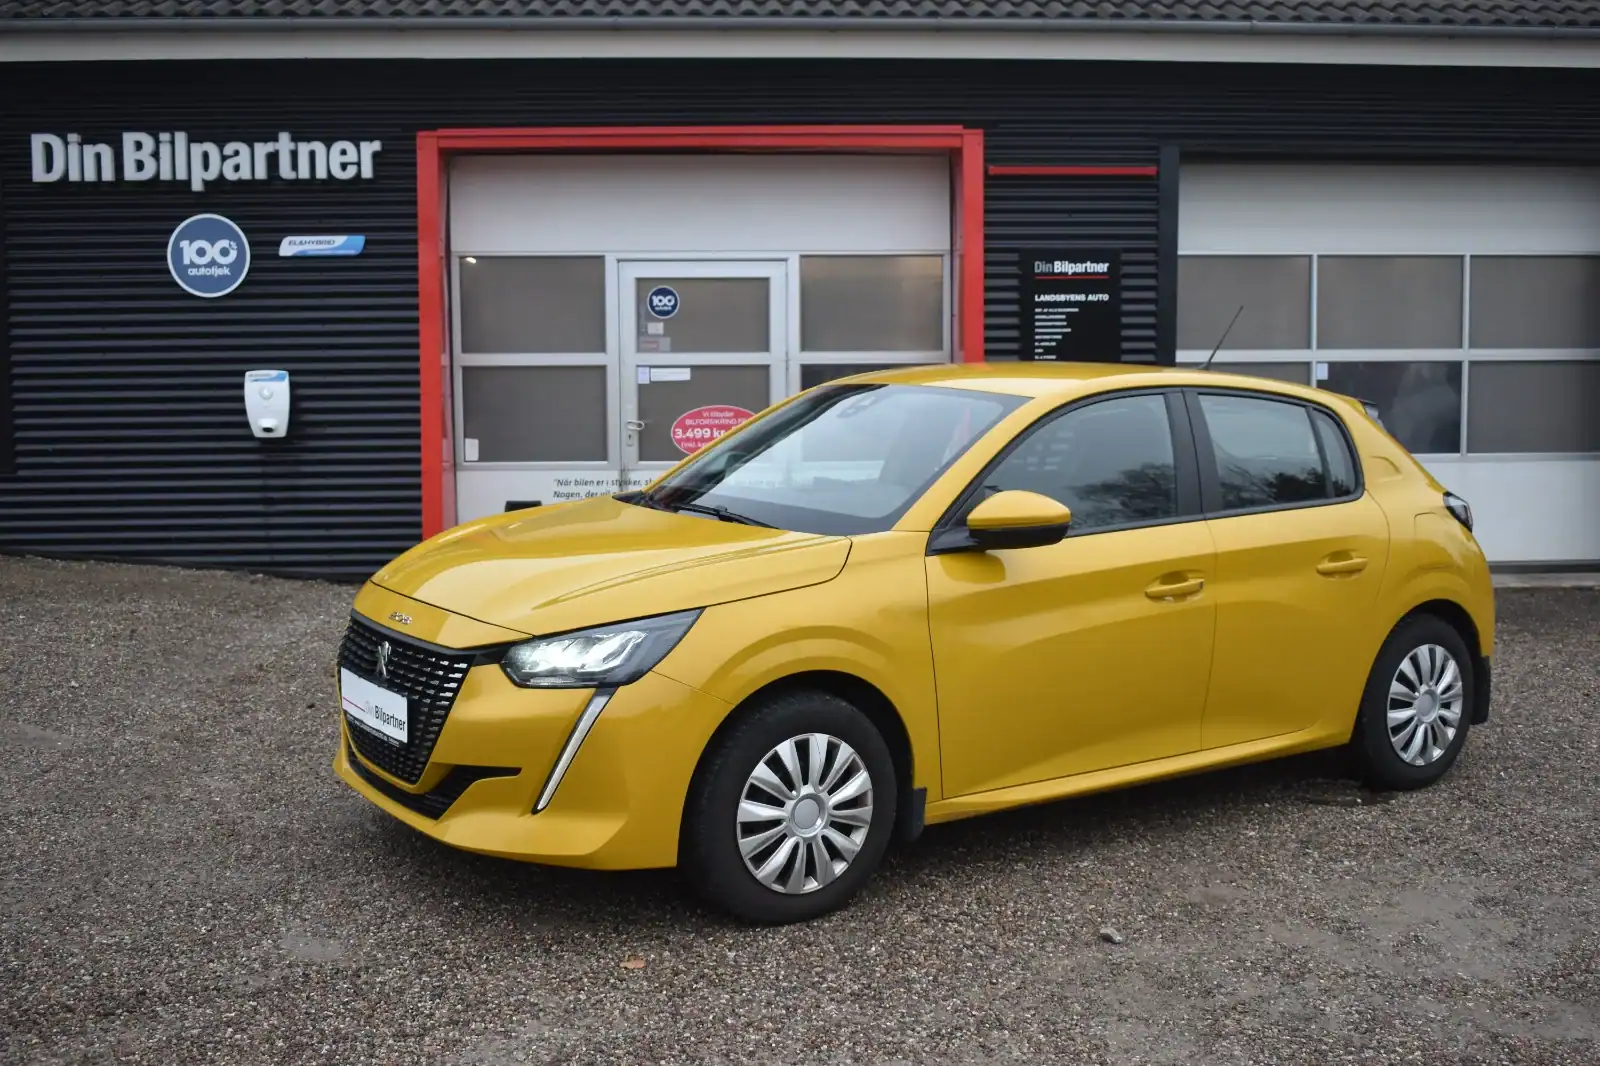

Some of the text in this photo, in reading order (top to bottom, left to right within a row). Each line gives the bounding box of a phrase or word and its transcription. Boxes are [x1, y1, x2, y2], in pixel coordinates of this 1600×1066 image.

[31, 131, 382, 191] Din Bilpartner
[187, 266, 231, 277] autotjek
[1034, 260, 1109, 275] Din Bilpartner
[1034, 294, 1109, 302] LANDSBYENS AUTO
[674, 428, 711, 439] 3.499
[574, 479, 595, 487] bilen
[553, 491, 583, 499] Nogen,
[374, 705, 406, 731] Bilpartner
